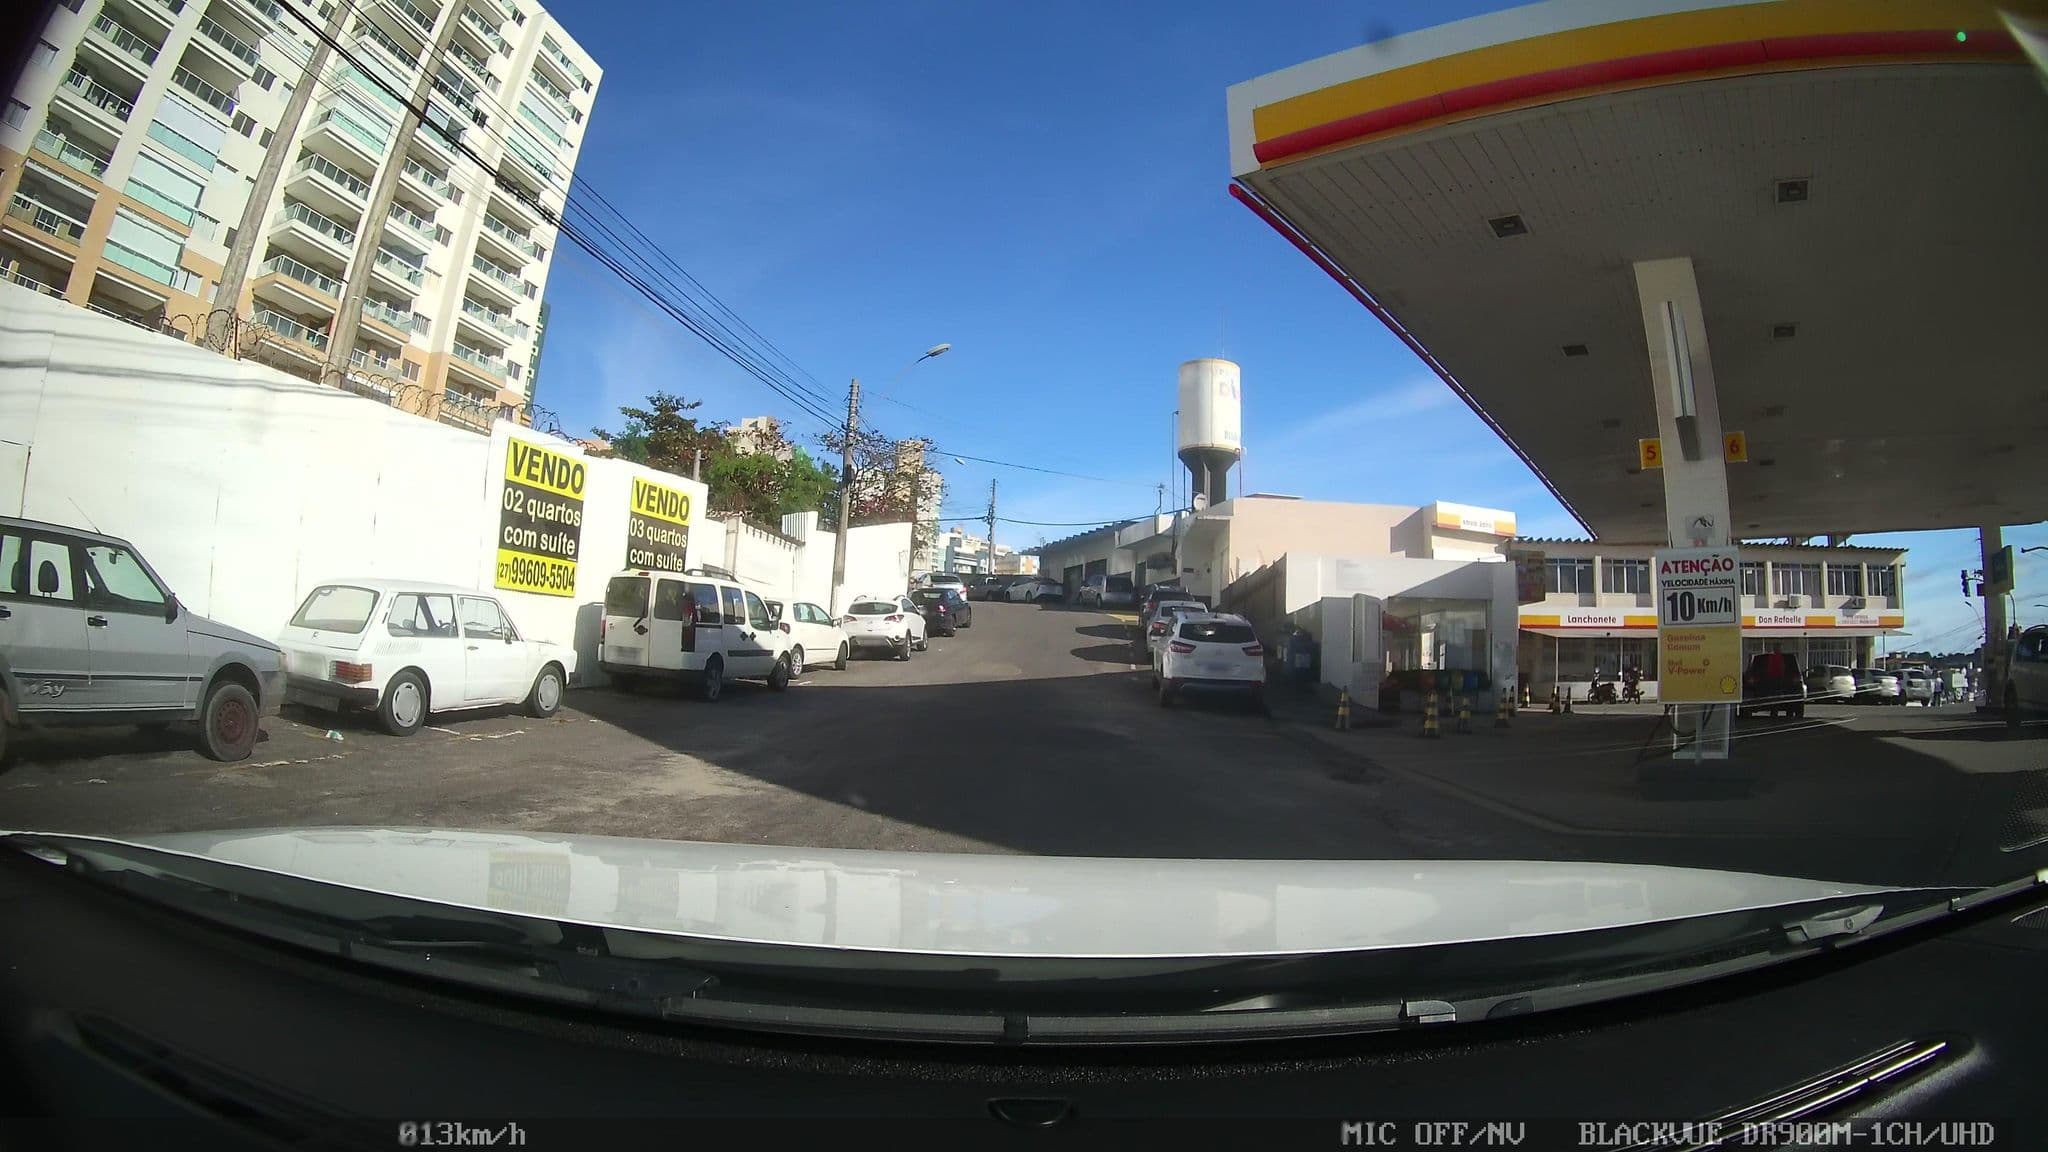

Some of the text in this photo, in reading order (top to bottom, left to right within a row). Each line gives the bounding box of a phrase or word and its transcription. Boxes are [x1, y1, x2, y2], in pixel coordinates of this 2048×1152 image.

[1646, 445, 1657, 460] 5
[1729, 439, 1741, 454] 6
[512, 441, 585, 495] VENDO
[503, 487, 582, 527] 02 quartos
[635, 479, 690, 522] VENDO
[503, 525, 576, 556] com suíte
[629, 517, 688, 549] 03 quartos
[629, 548, 683, 572] com suíte
[1661, 554, 1735, 576] ATENÇÃO
[497, 556, 576, 592] (27) 99609-5504
[1661, 577, 1735, 588] VELOCIDADE MÁXIMA
[1567, 614, 1617, 624] Lanchonete
[1666, 591, 1733, 622] 10 Km/h
[1774, 615, 1802, 624] Rafaelle
